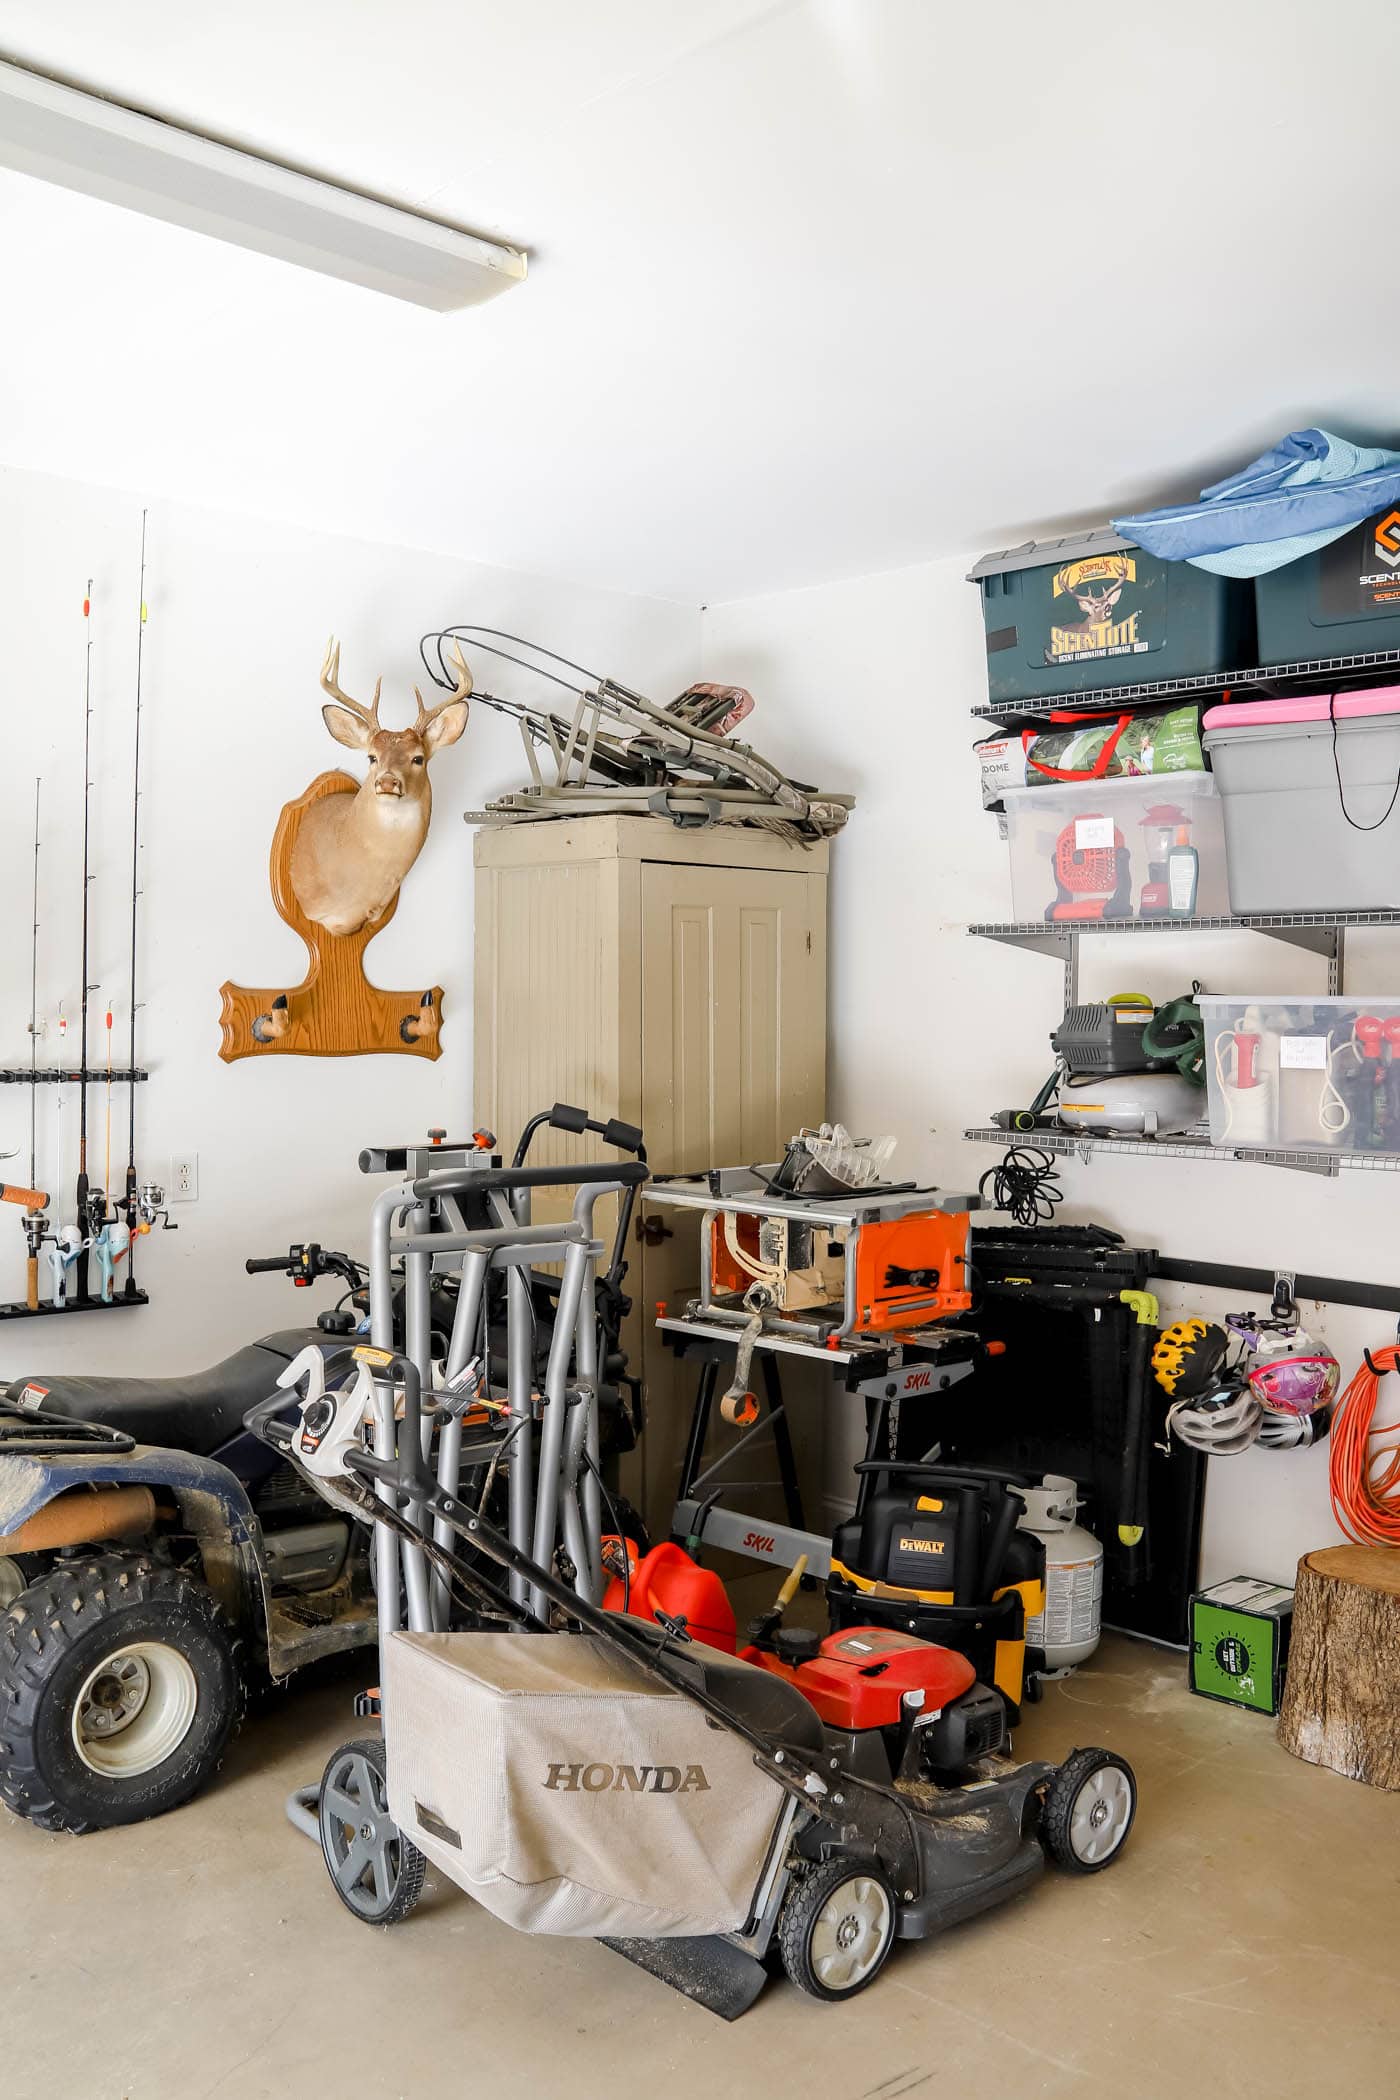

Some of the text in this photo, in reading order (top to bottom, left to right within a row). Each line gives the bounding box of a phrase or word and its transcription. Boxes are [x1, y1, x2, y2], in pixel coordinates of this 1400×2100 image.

[904, 1372, 931, 1391] SKIL
[743, 1532, 775, 1553] SKIL
[541, 1762, 712, 1793] HONDA
